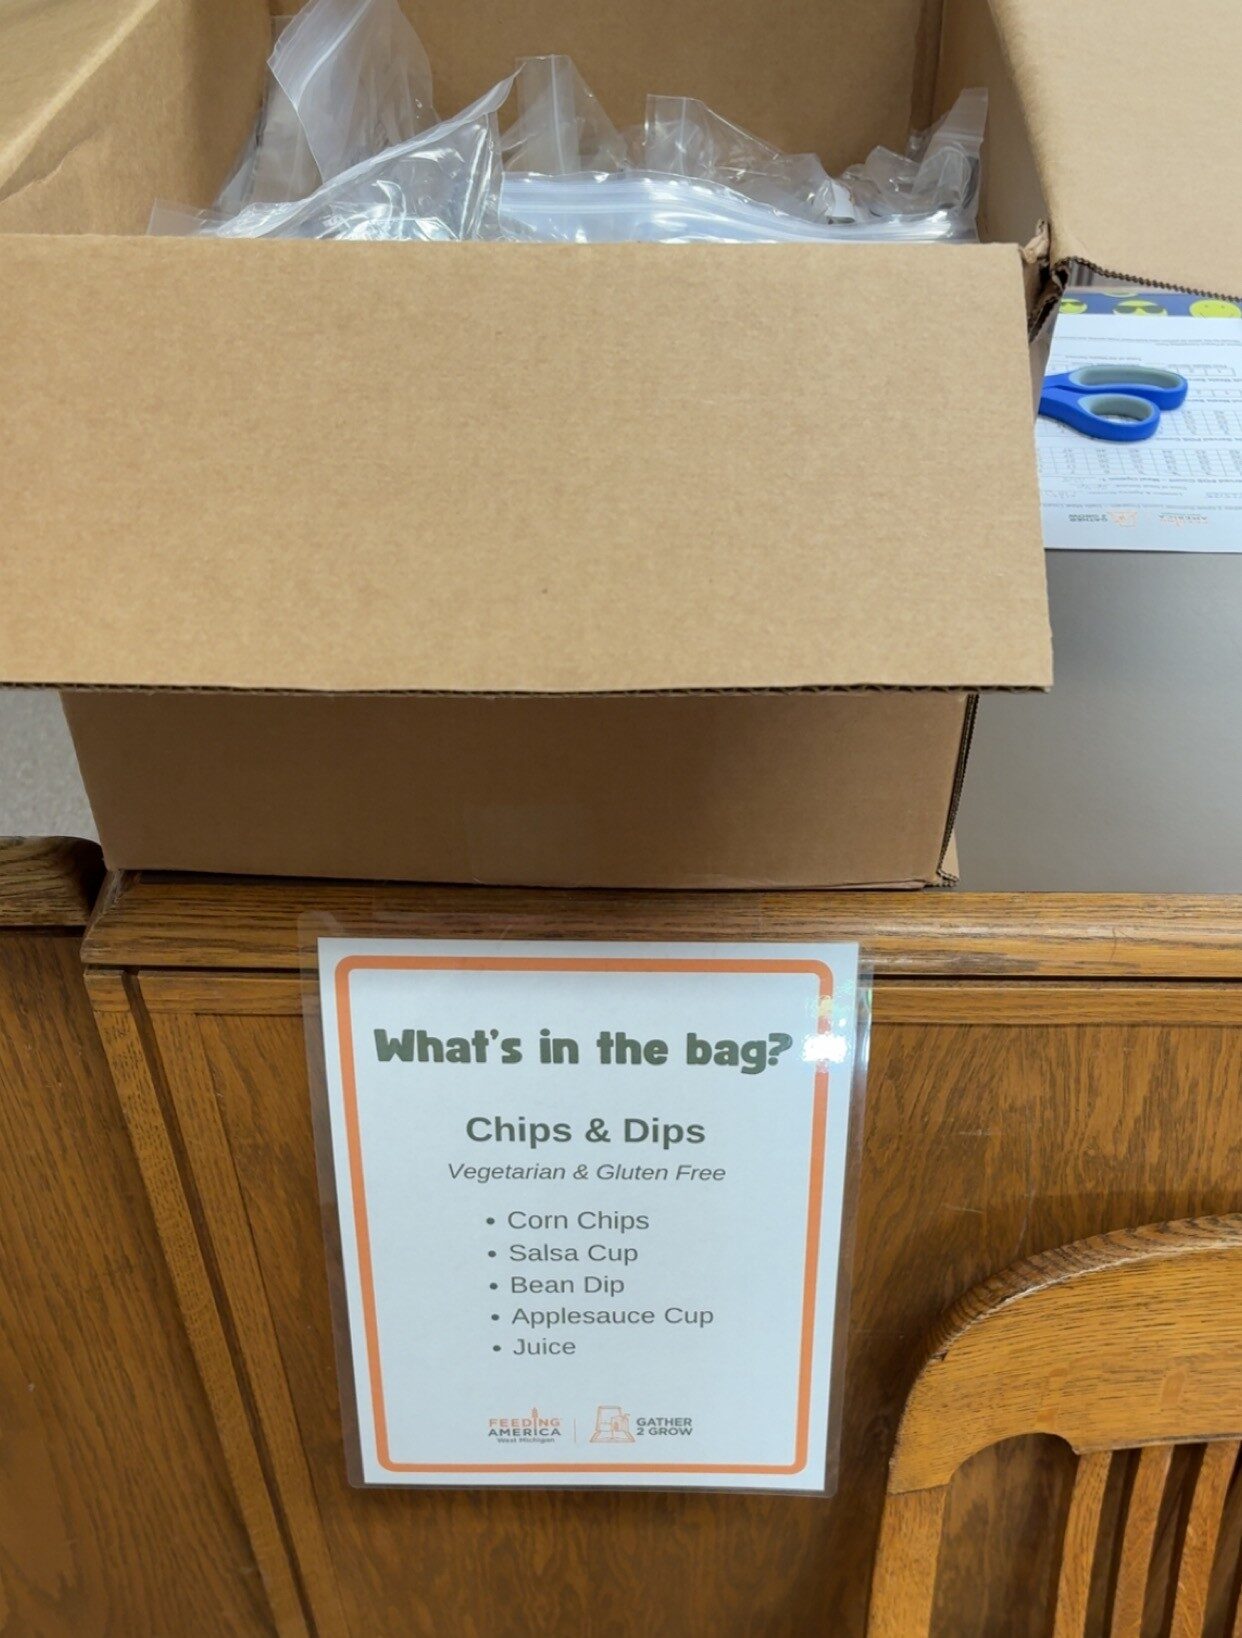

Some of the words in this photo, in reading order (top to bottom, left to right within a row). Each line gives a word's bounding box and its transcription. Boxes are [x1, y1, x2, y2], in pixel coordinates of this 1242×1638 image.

[373, 1028, 523, 1065] What's
[539, 1028, 580, 1065] in
[595, 1031, 669, 1067] the
[685, 1031, 794, 1076] bag?
[465, 1116, 573, 1150] Chips
[584, 1117, 612, 1144] &
[623, 1116, 706, 1151] Dips
[447, 1162, 566, 1184] Vegetarian
[572, 1163, 589, 1181] &
[596, 1163, 669, 1181] Gluten
[675, 1164, 727, 1182] Free
[507, 1210, 568, 1231] Corn
[577, 1210, 650, 1235] Chips
[509, 1243, 580, 1263] Salsa
[587, 1244, 639, 1267] Cup
[510, 1275, 575, 1294] Bean
[584, 1275, 625, 1298] Dip
[511, 1306, 656, 1329] Applesauce
[664, 1307, 714, 1329] Cup
[512, 1337, 576, 1357] Juice
[487, 1427, 562, 1437] AMERICA
[488, 1416, 561, 1428] FEEDING
[636, 1417, 693, 1427] GATHER
[636, 1427, 645, 1436] 2
[648, 1427, 694, 1436] GROW
